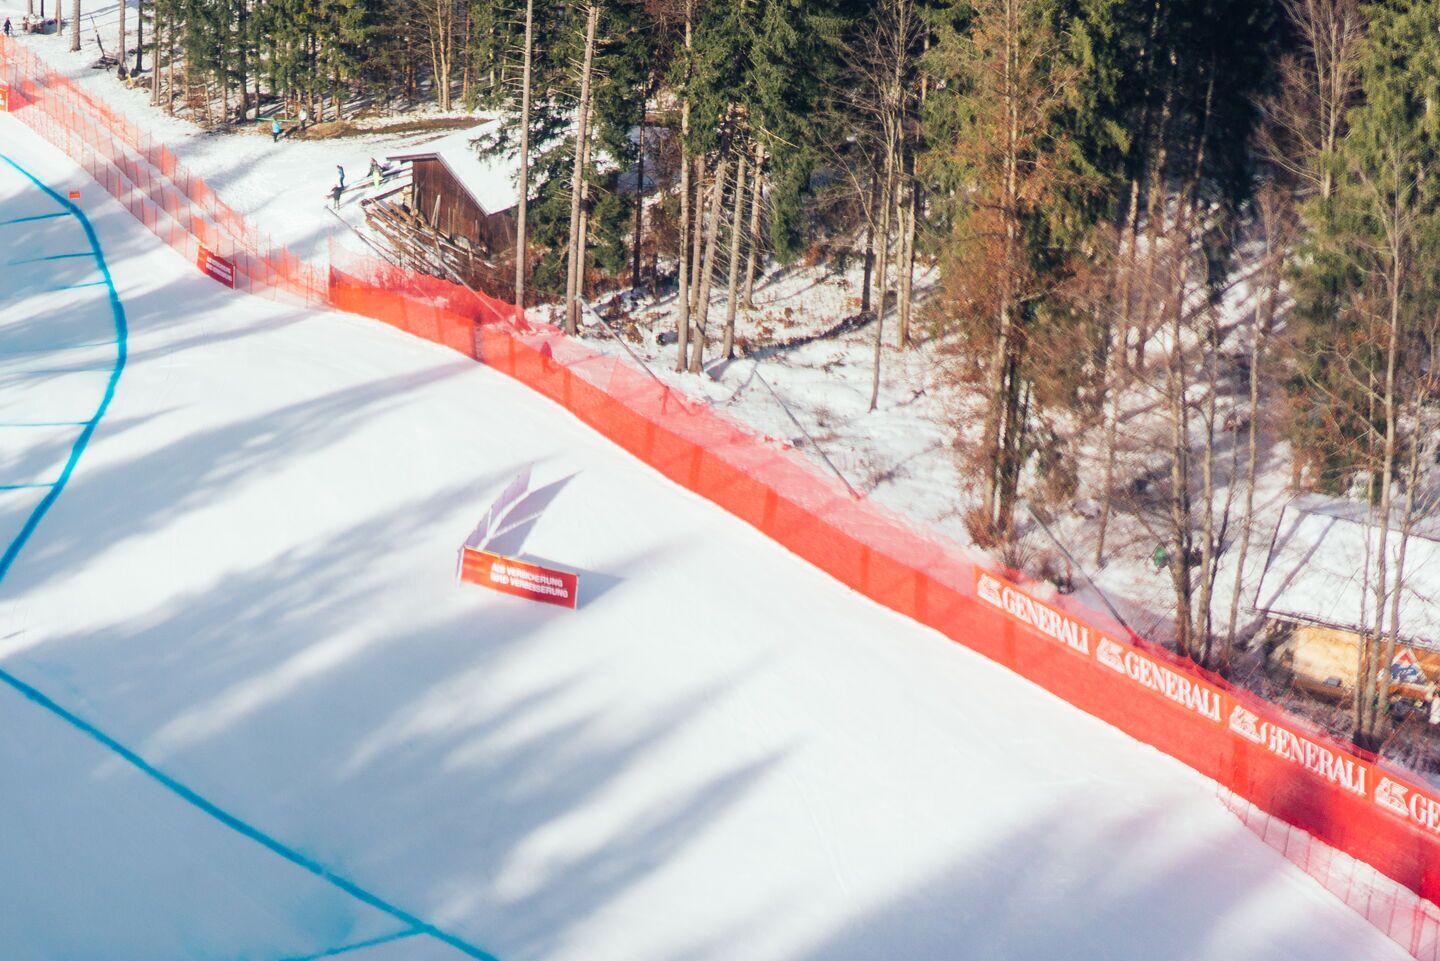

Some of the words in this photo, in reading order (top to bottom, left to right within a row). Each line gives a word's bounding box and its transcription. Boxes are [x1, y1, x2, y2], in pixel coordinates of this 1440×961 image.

[1002, 586, 1090, 656] GENERALI
[1124, 651, 1222, 722] GENERALI
[1260, 721, 1367, 797] GENERALI
